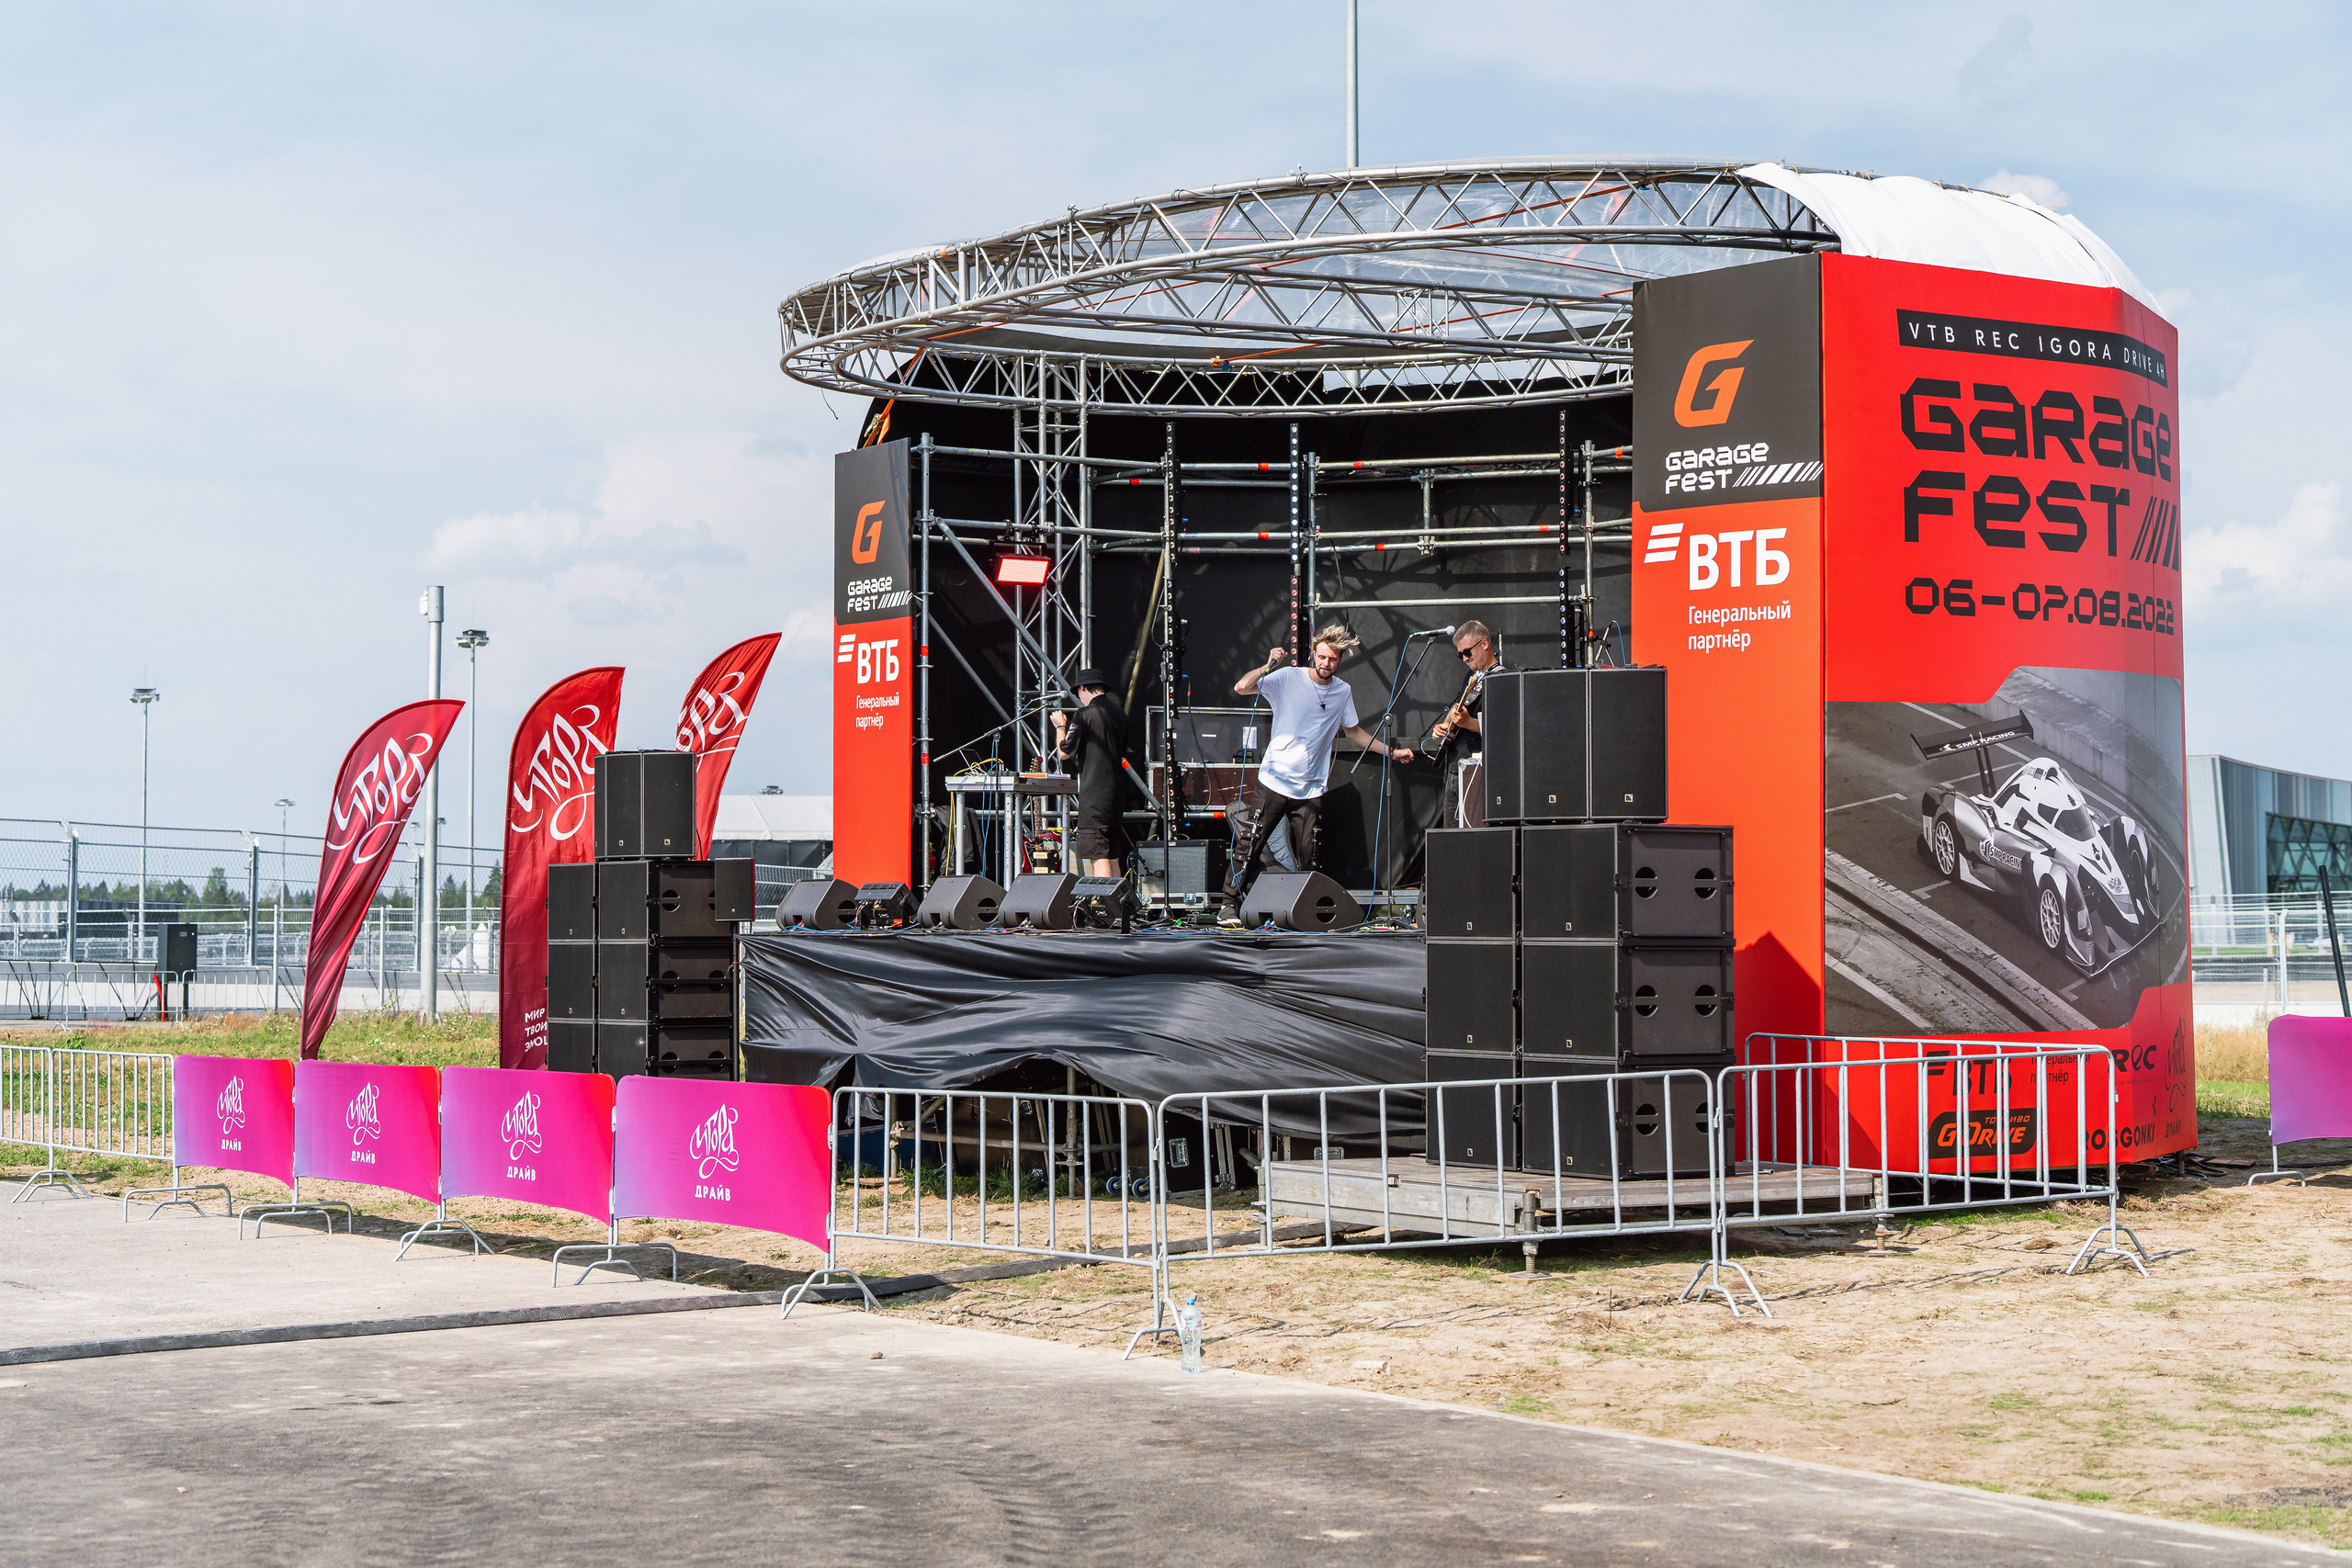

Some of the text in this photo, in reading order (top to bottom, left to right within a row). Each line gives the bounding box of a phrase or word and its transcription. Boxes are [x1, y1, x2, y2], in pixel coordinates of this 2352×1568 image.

[1909, 321, 1955, 344] VTB
[1975, 329, 2020, 350] REC
[2038, 335, 2112, 361] IGORA
[2123, 346, 2153, 373] DRIVE
[1689, 527, 1791, 591] ВТБ
[1688, 600, 1792, 627] Генеральный
[1688, 628, 1751, 654] партнёр
[856, 638, 899, 684] ВТБ
[855, 692, 900, 712] Генеральный
[855, 713, 884, 730] партнёр
[2002, 851, 2022, 870] RACIN
[525, 1008, 546, 1023] МИР
[524, 1021, 548, 1037] ТВОИ
[2030, 1069, 2069, 1086] птнёр
[1984, 1115, 2030, 1124] ТОИВО
[220, 1138, 242, 1151] ДРАЙВ
[350, 1150, 376, 1165] ДРАЙВ
[506, 1166, 537, 1181] ДРАЙВ
[695, 1184, 731, 1201] ДРАЙВ
